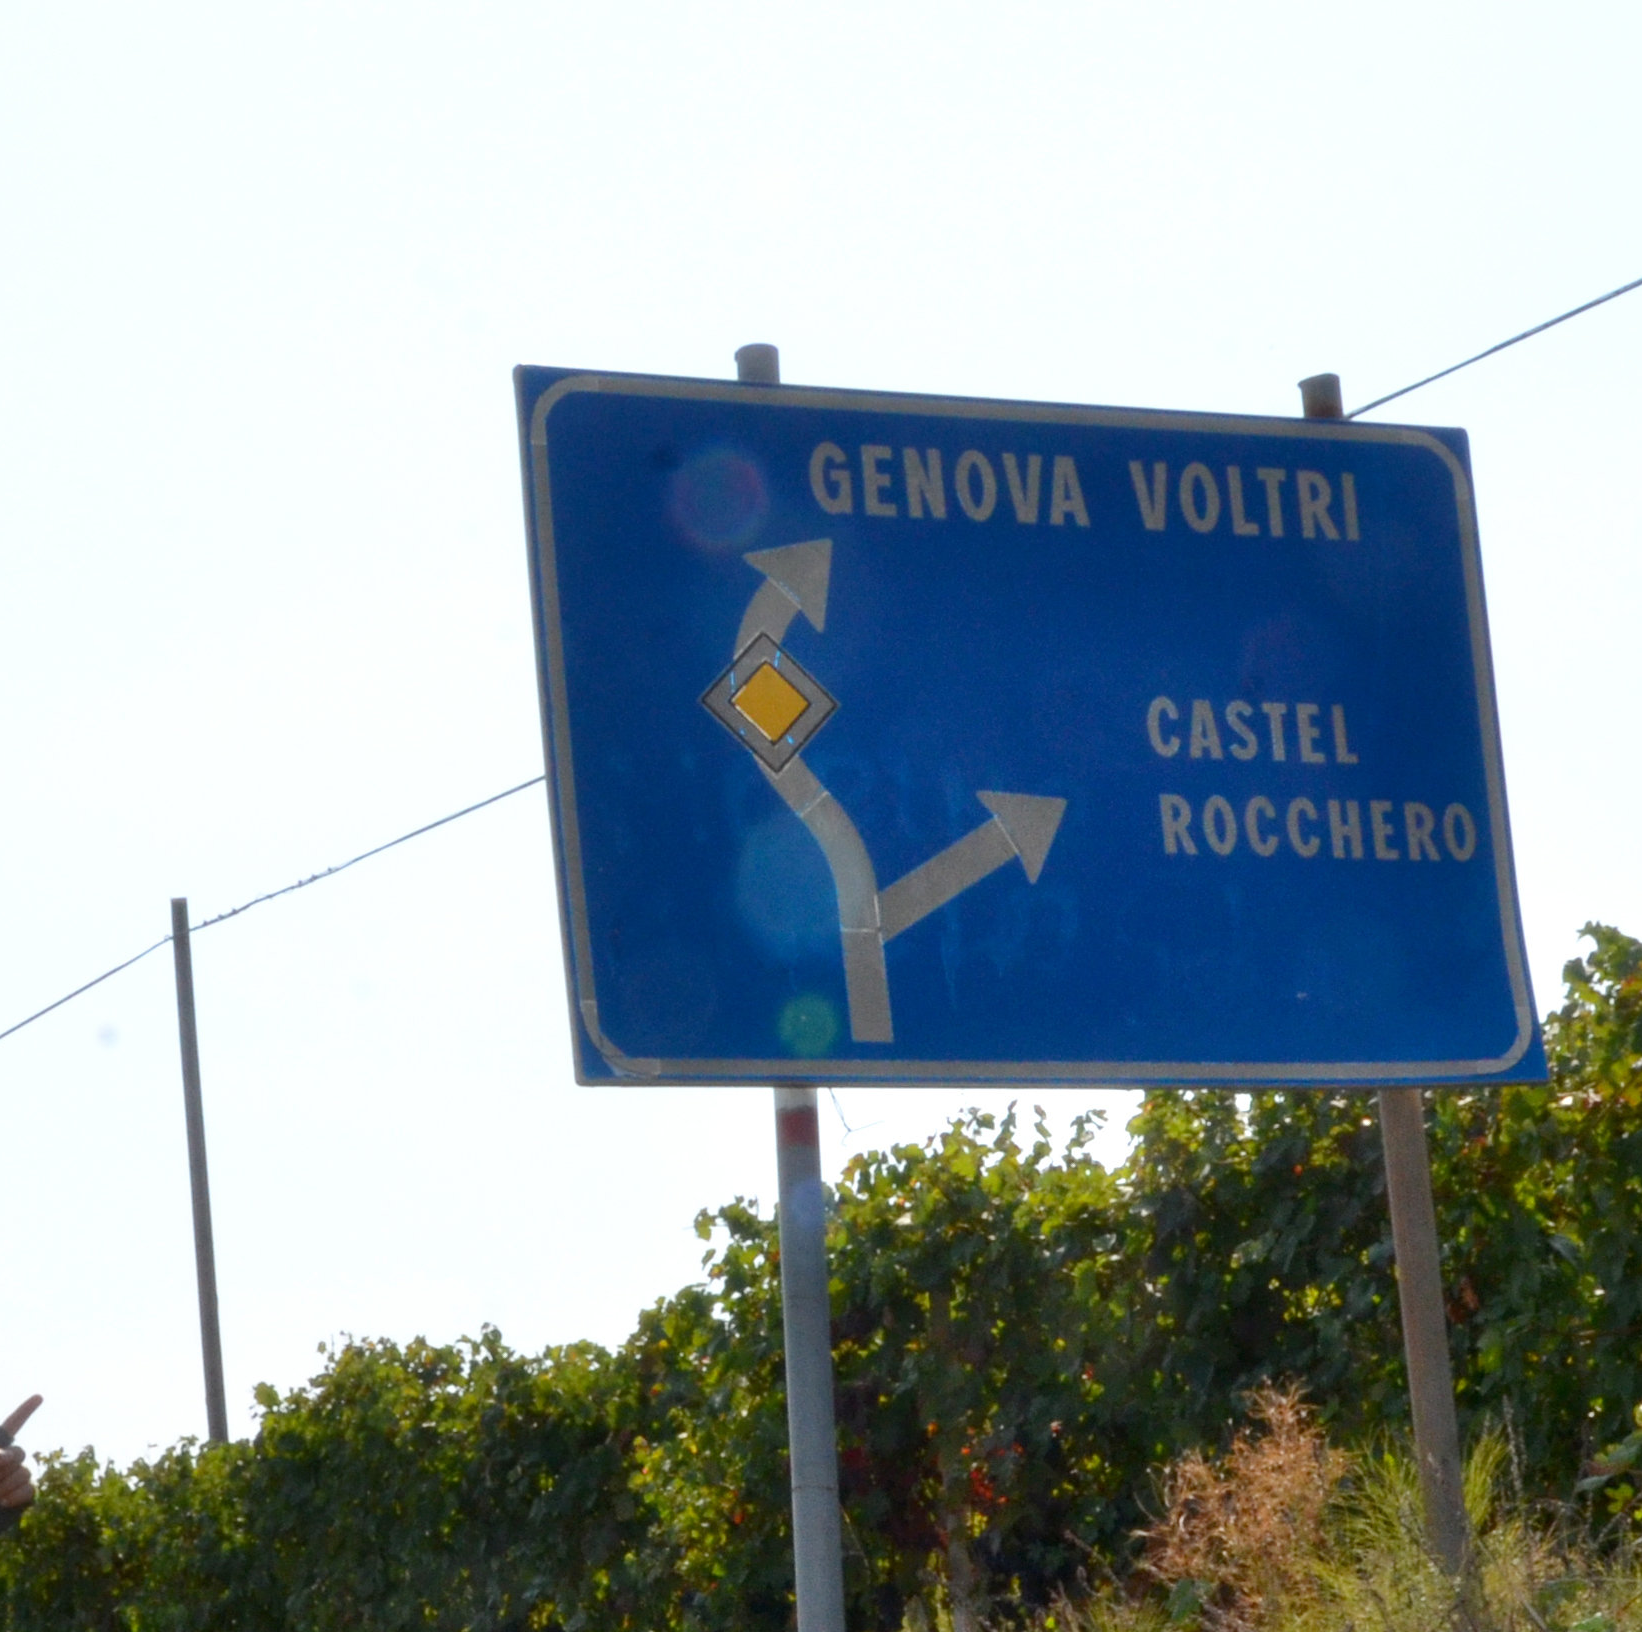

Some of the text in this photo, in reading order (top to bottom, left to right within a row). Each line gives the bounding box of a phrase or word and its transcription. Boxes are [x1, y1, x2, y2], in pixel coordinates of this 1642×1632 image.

[809, 441, 1360, 541] GENOVA VOLTRI
[1147, 695, 1358, 764] CASTEL
[1158, 793, 1476, 862] ROCCHERO
